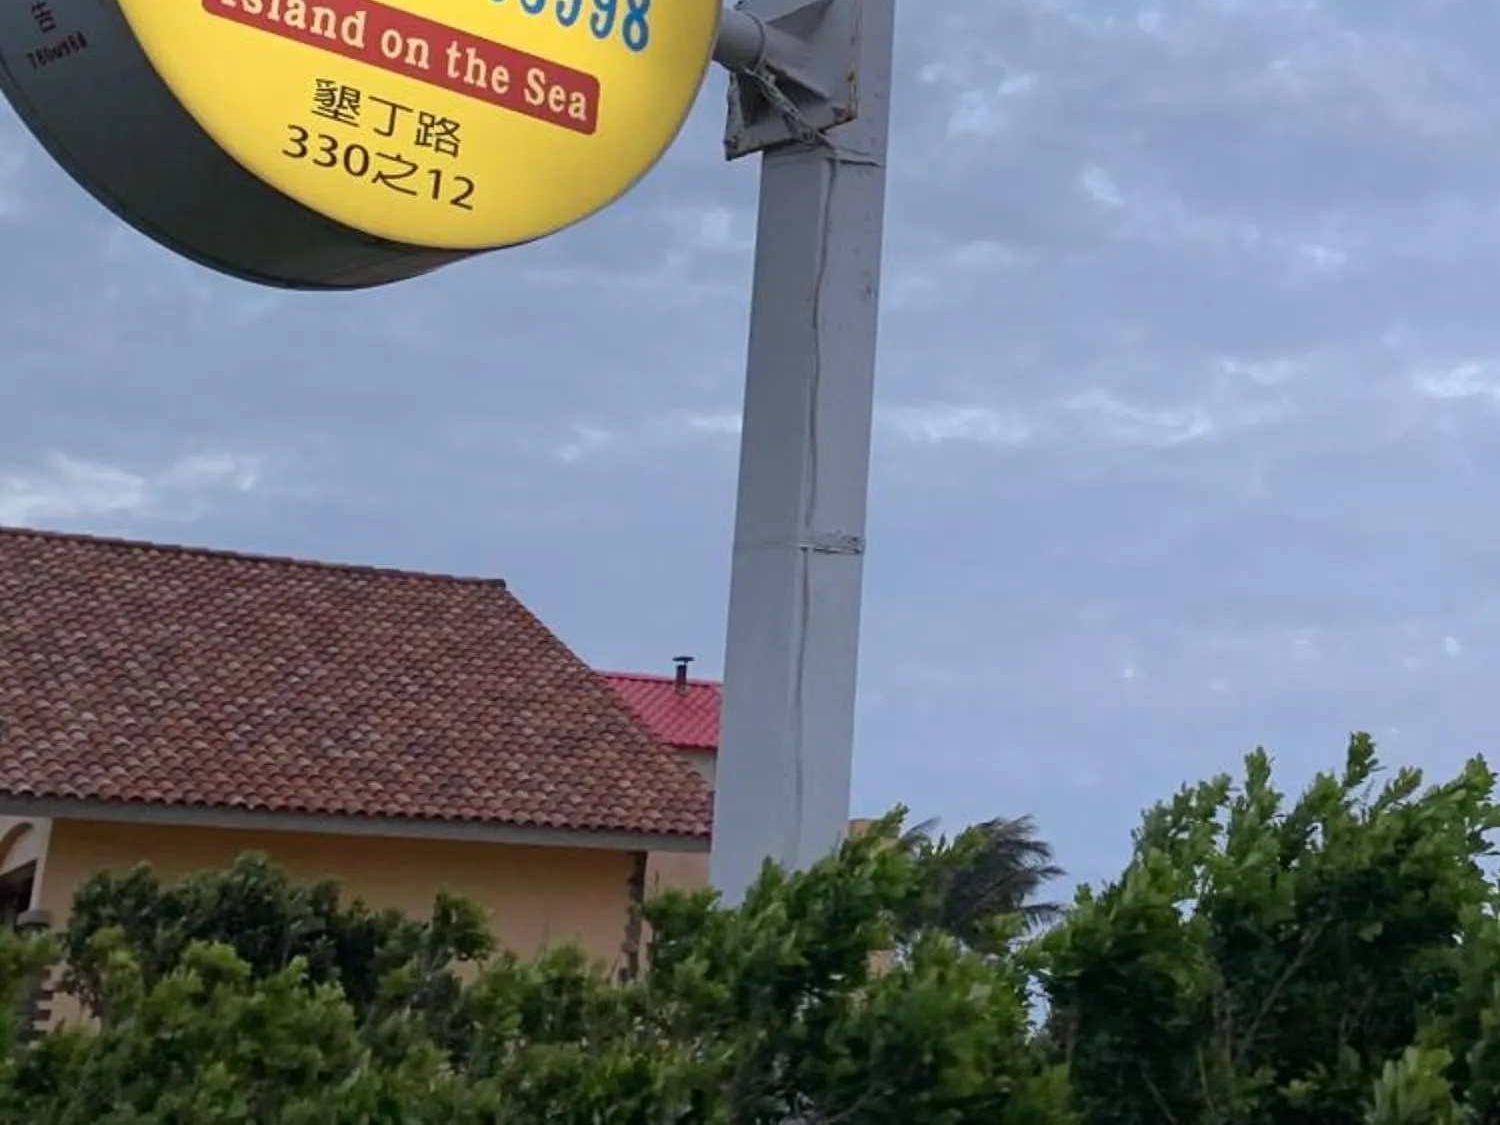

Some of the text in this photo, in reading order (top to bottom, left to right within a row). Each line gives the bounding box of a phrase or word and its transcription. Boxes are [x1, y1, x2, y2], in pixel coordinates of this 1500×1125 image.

[380, 28, 430, 69] on
[447, 41, 509, 94] the
[523, 68, 587, 122] Sea
[311, 78, 461, 159] 墾丁路
[282, 124, 475, 210] 330之12
